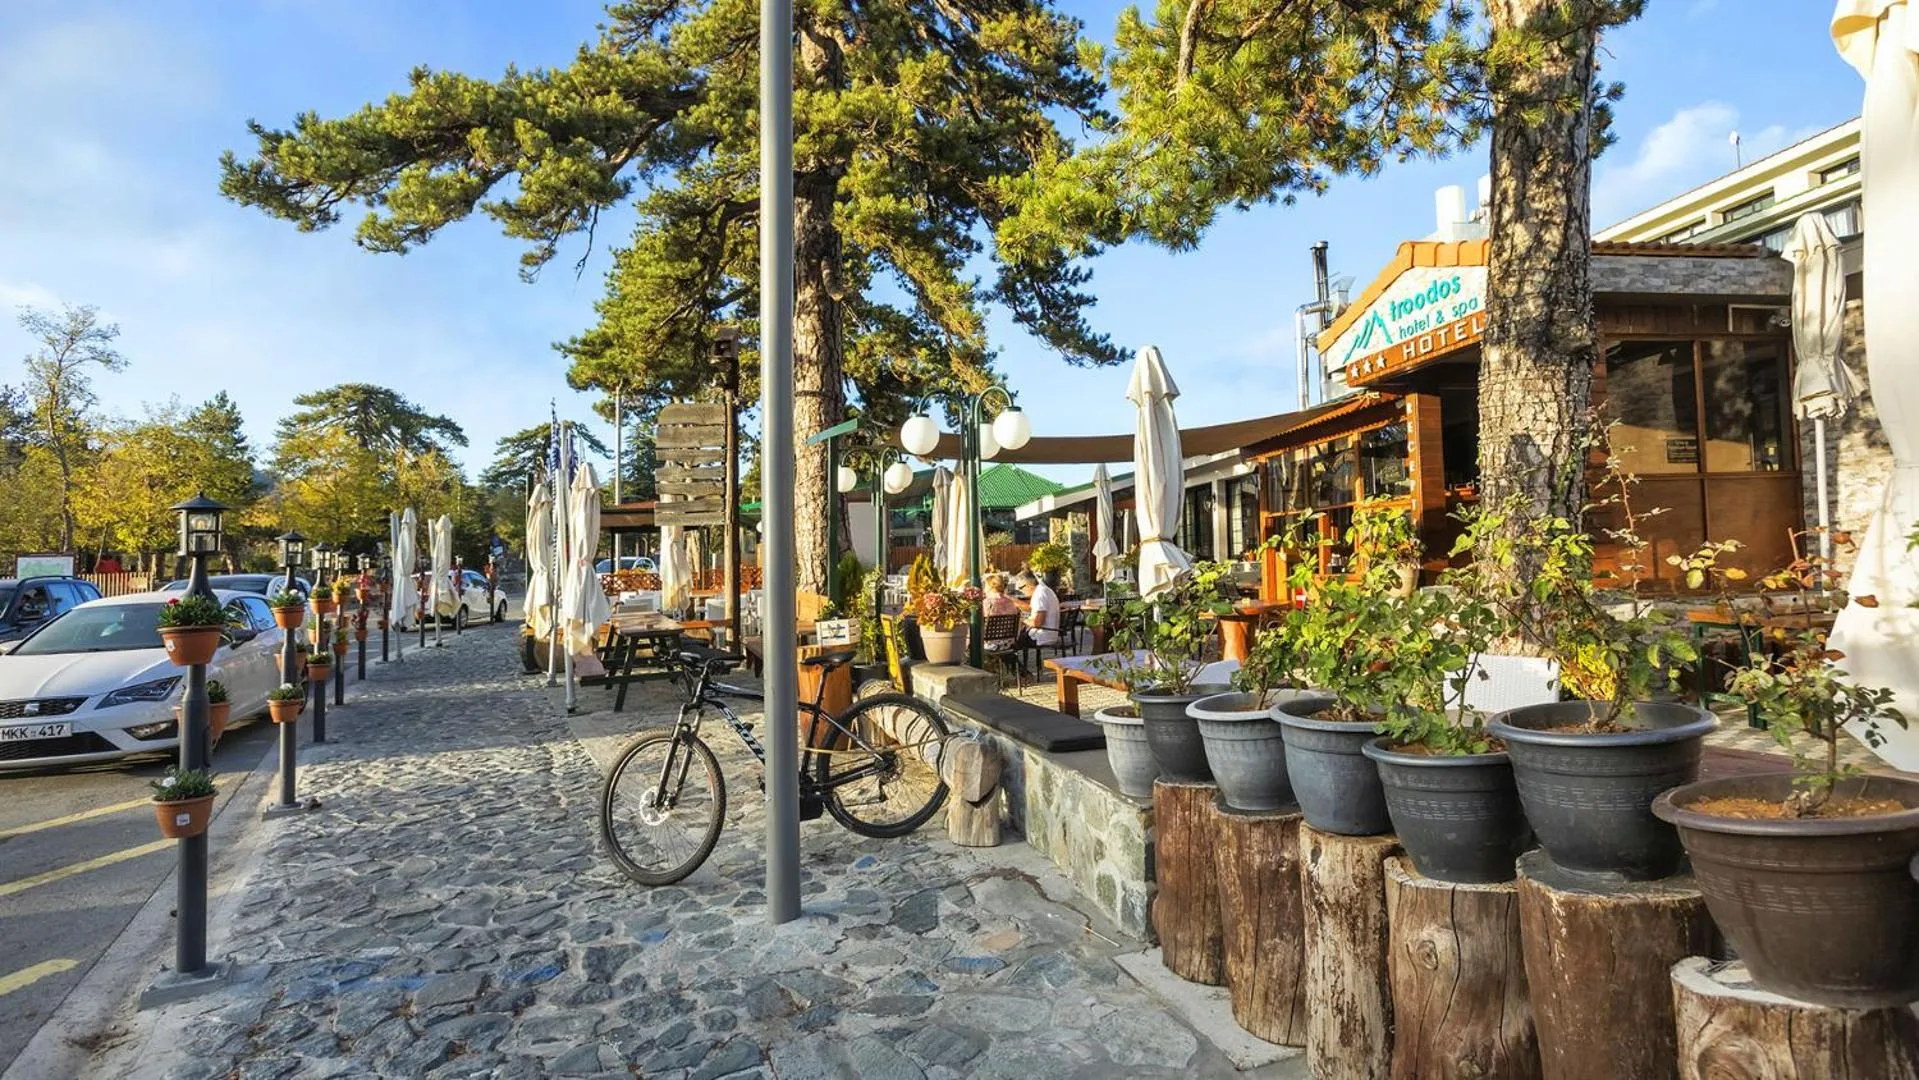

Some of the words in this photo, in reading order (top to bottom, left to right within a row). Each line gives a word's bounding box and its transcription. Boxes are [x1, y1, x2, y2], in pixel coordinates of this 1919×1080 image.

[1389, 275, 1461, 322] troodos
[1399, 313, 1430, 339] hotel
[1435, 309, 1445, 324] &
[1451, 296, 1478, 318] spa
[1402, 316, 1485, 361] HOTEL
[1, 727, 29, 740] MKK
[38, 724, 65, 737] 417
